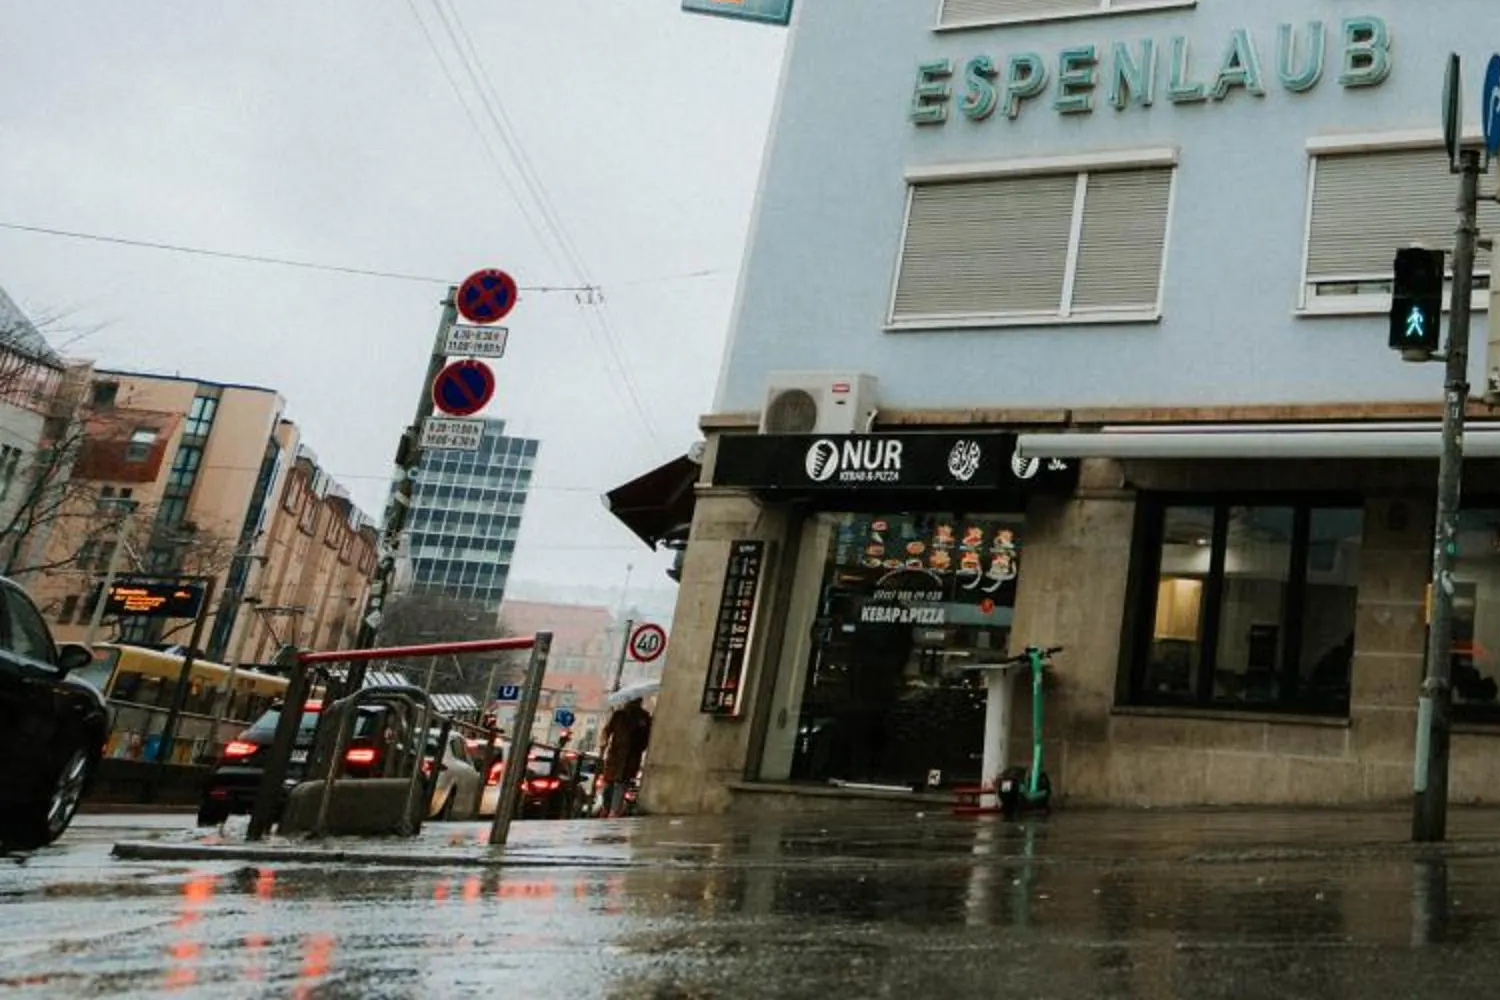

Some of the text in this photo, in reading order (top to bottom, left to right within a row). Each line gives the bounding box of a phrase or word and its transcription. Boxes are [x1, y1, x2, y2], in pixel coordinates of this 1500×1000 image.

[909, 14, 1393, 126] ESPENLAUB
[841, 439, 903, 470] NUR
[636, 633, 659, 653] 40
